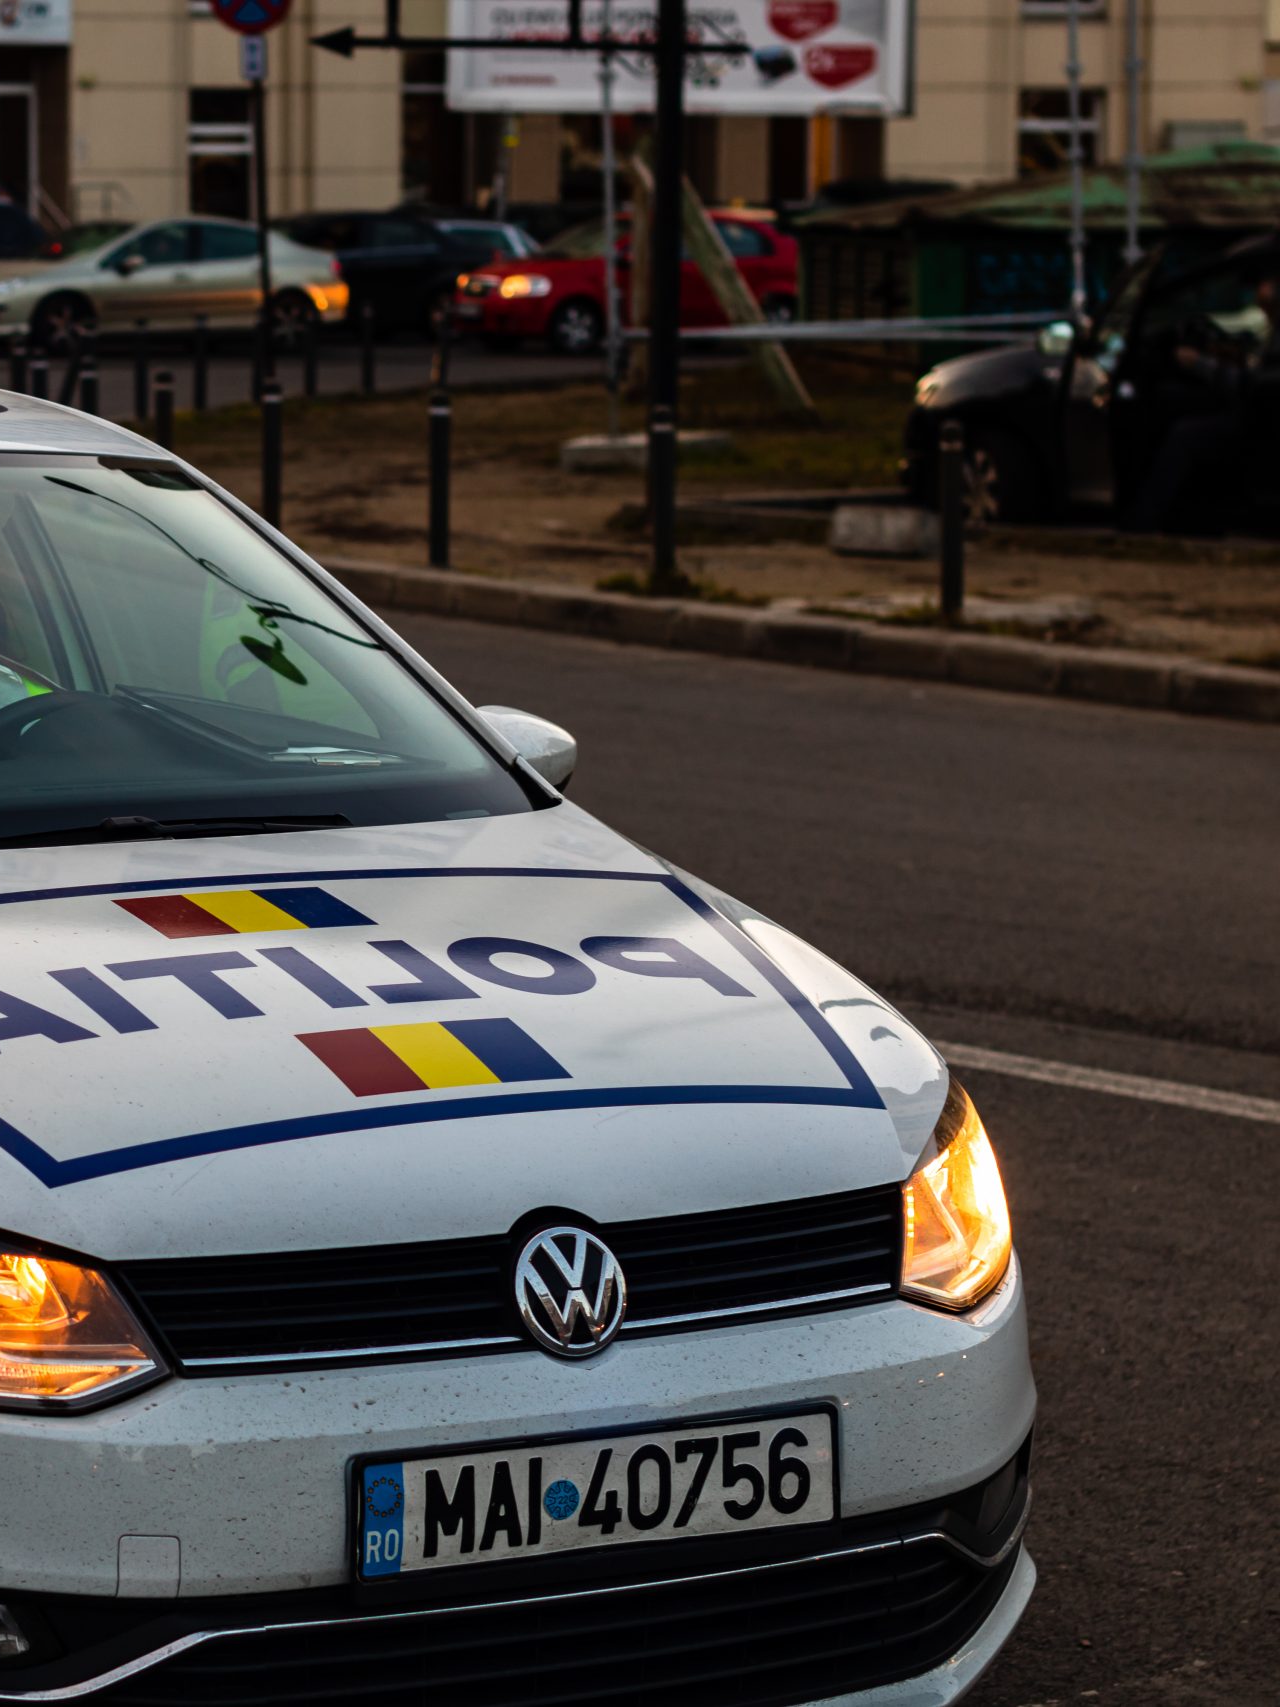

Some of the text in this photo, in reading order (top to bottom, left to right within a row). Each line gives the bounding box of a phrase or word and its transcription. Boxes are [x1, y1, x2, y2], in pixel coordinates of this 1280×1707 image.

[423, 1427, 811, 1558] MAI 40756
[365, 1529, 400, 1564] RO
